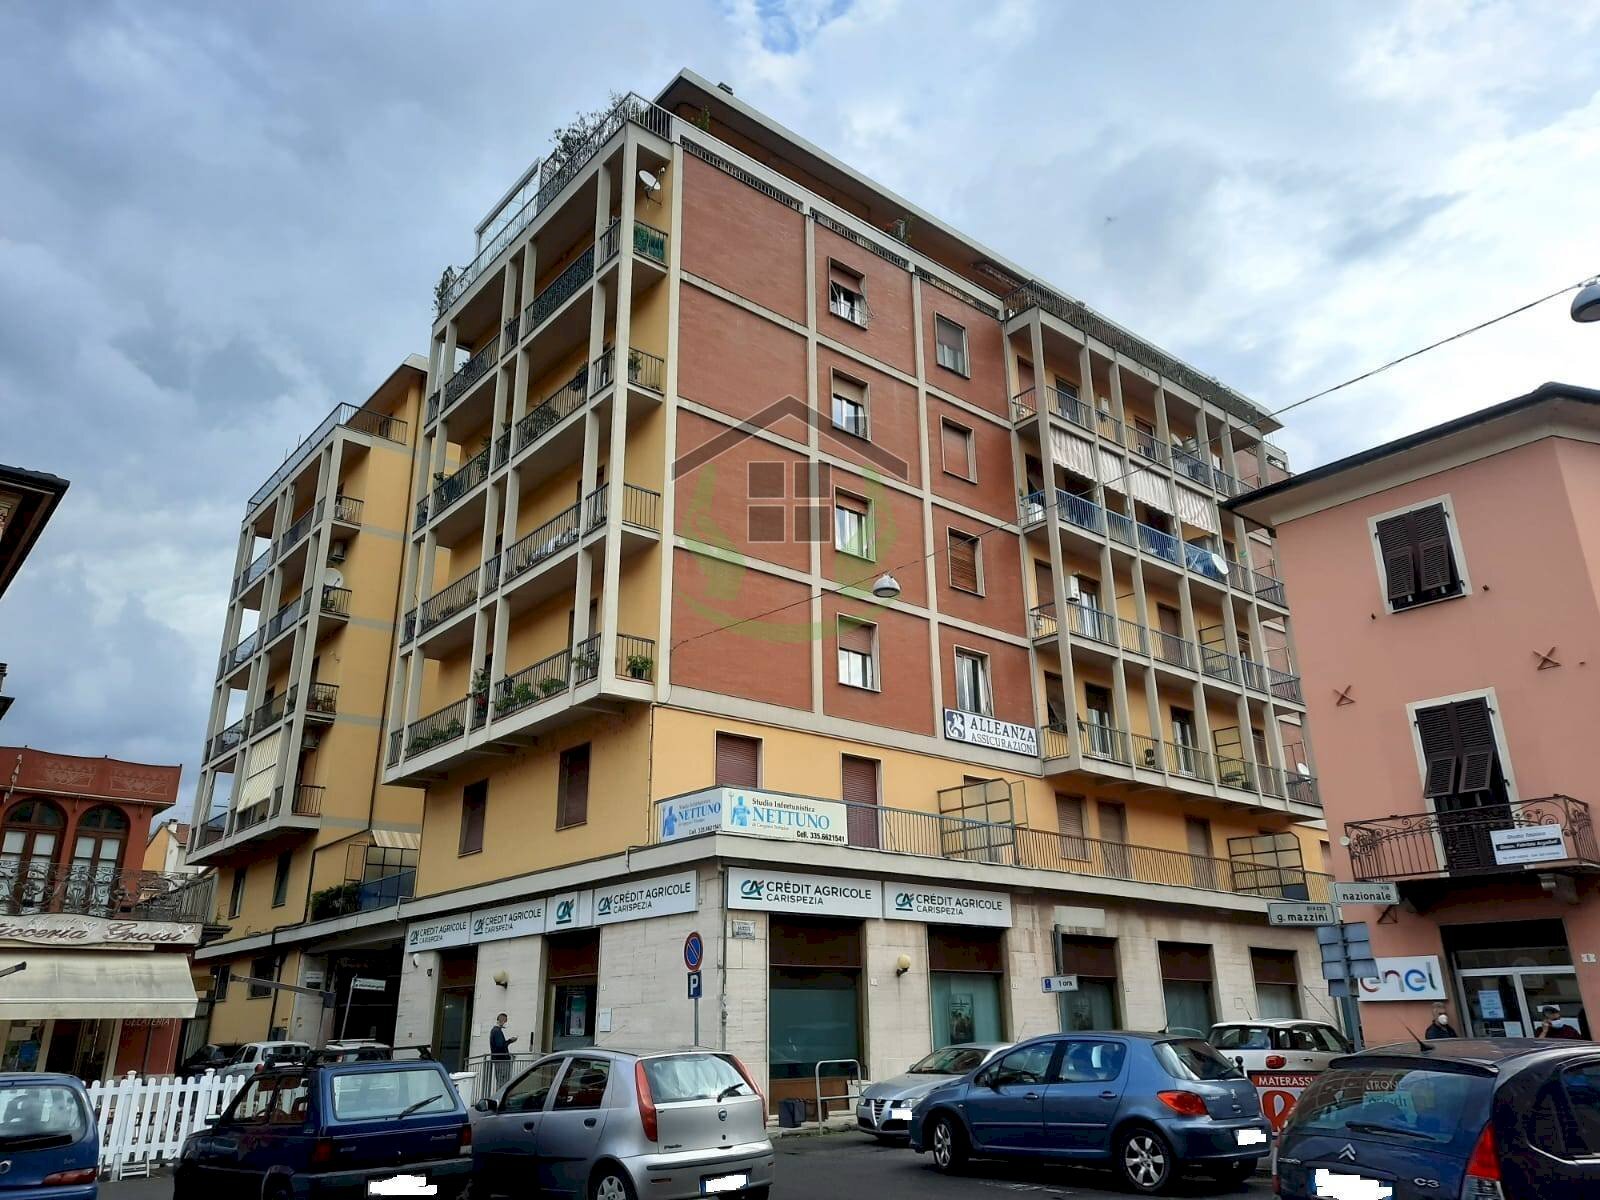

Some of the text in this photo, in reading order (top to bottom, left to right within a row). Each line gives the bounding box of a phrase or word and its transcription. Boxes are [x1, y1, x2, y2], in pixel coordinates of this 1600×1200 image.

[970, 717, 1035, 742] ALLEANZA
[971, 733, 1036, 754] ASSICURAZIONI
[752, 797, 772, 807] Studio
[679, 802, 720, 820] NETTUNO
[752, 807, 830, 830] NETTUNO
[796, 830, 845, 842] Cell. 335.6621541
[614, 882, 690, 904] CRÉDIT AGRICOLE
[766, 880, 872, 900] CRÉDIT AGRICOLE
[1342, 892, 1391, 900] nazionale
[613, 902, 652, 914] CARISPEZIA
[766, 894, 824, 905] CARISPEZIA
[916, 893, 1002, 910] CRÉDIT AGRICOLE
[486, 908, 542, 926] CRÉDIT AGRICOLE
[917, 906, 964, 916] CARISPEZIA
[1288, 912, 1328, 921] mazzini
[102, 922, 188, 942] Grossi
[439, 921, 467, 933] AGRICOLE
[690, 974, 698, 995] P
[1360, 962, 1438, 992] enel
[1414, 1178, 1440, 1188] C3
